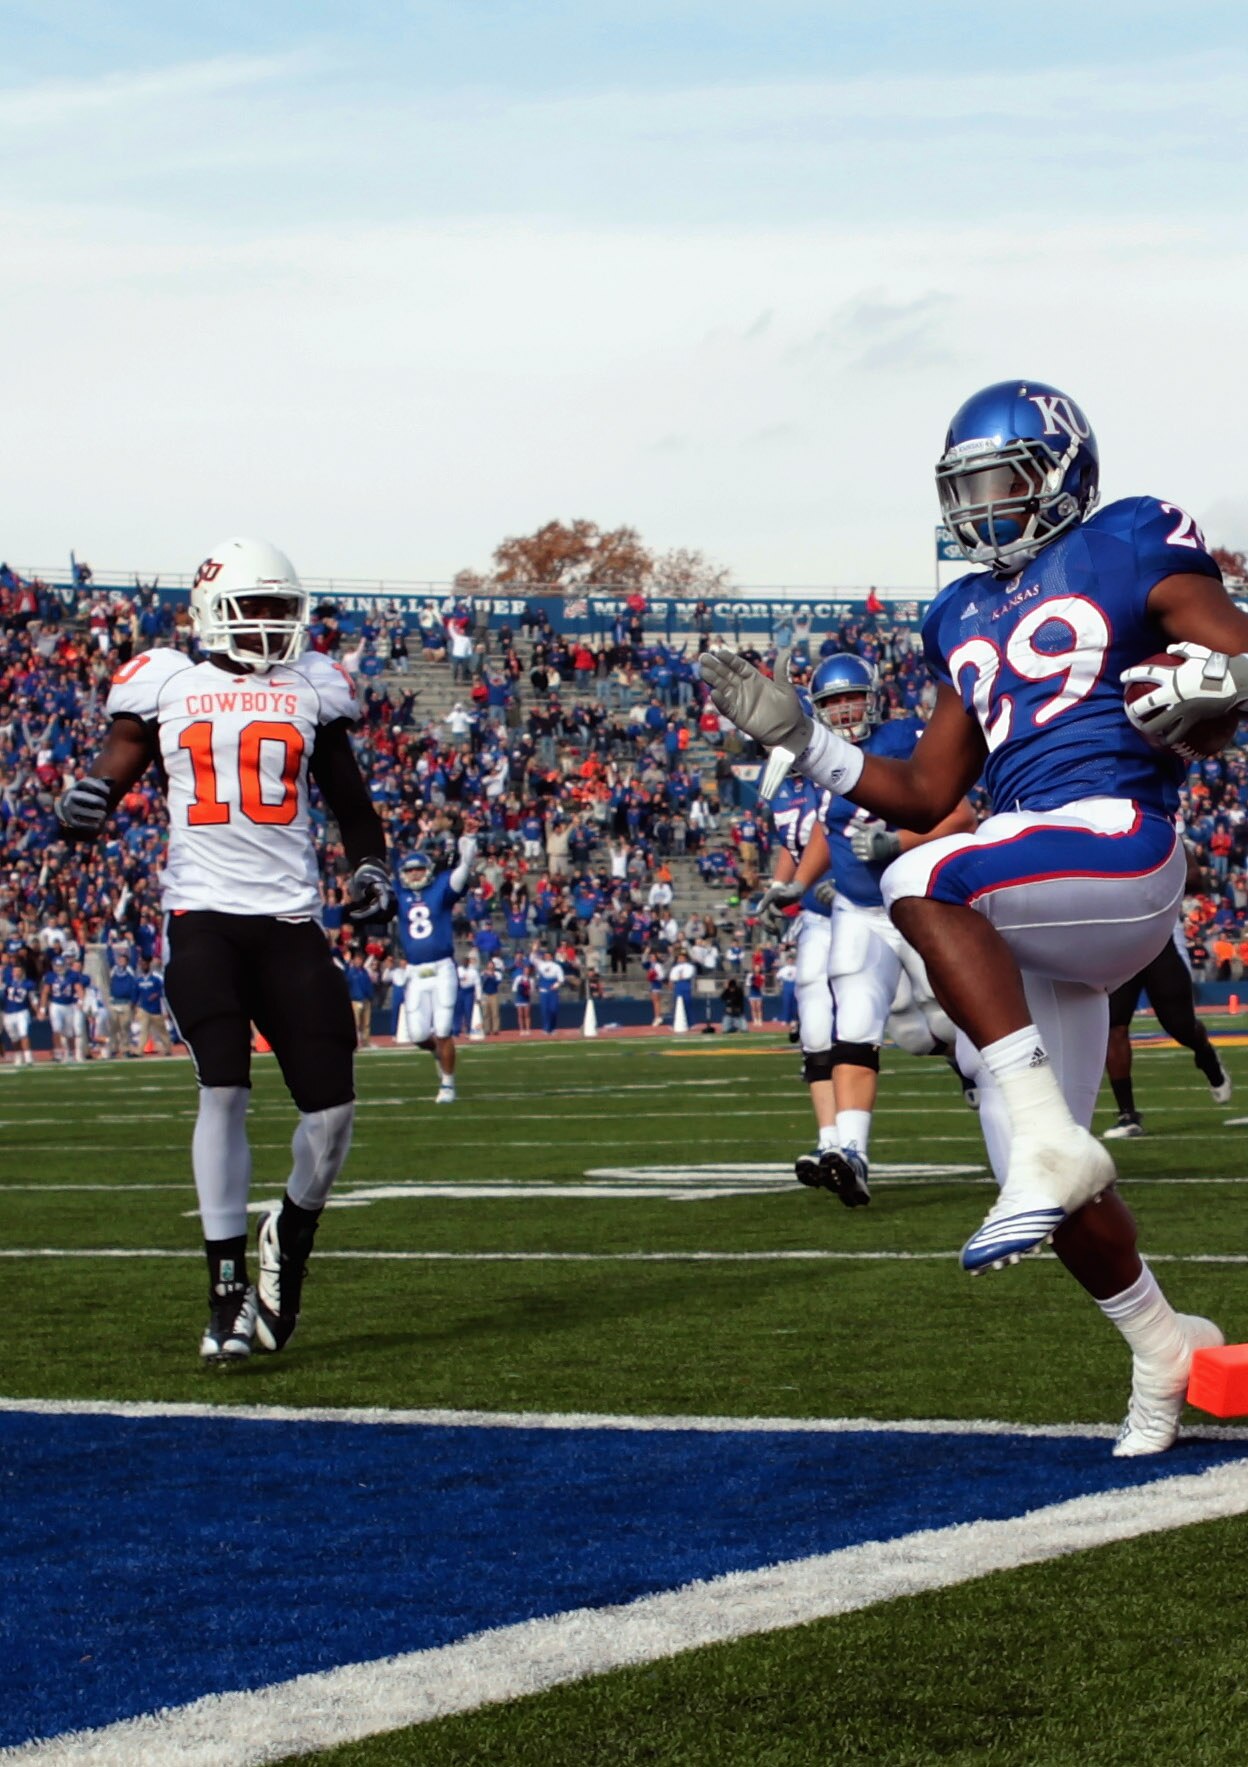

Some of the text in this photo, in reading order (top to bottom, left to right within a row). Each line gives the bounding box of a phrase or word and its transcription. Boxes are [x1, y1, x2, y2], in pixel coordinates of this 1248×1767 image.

[1029, 396, 1090, 439] KU
[1160, 502, 1208, 553] 2
[675, 602, 853, 619] MCORMACK
[991, 584, 1041, 621] KANSAS
[949, 593, 1112, 753] 29
[186, 692, 298, 716] COWBOYS
[178, 720, 305, 826] 10
[408, 905, 433, 940] 8
